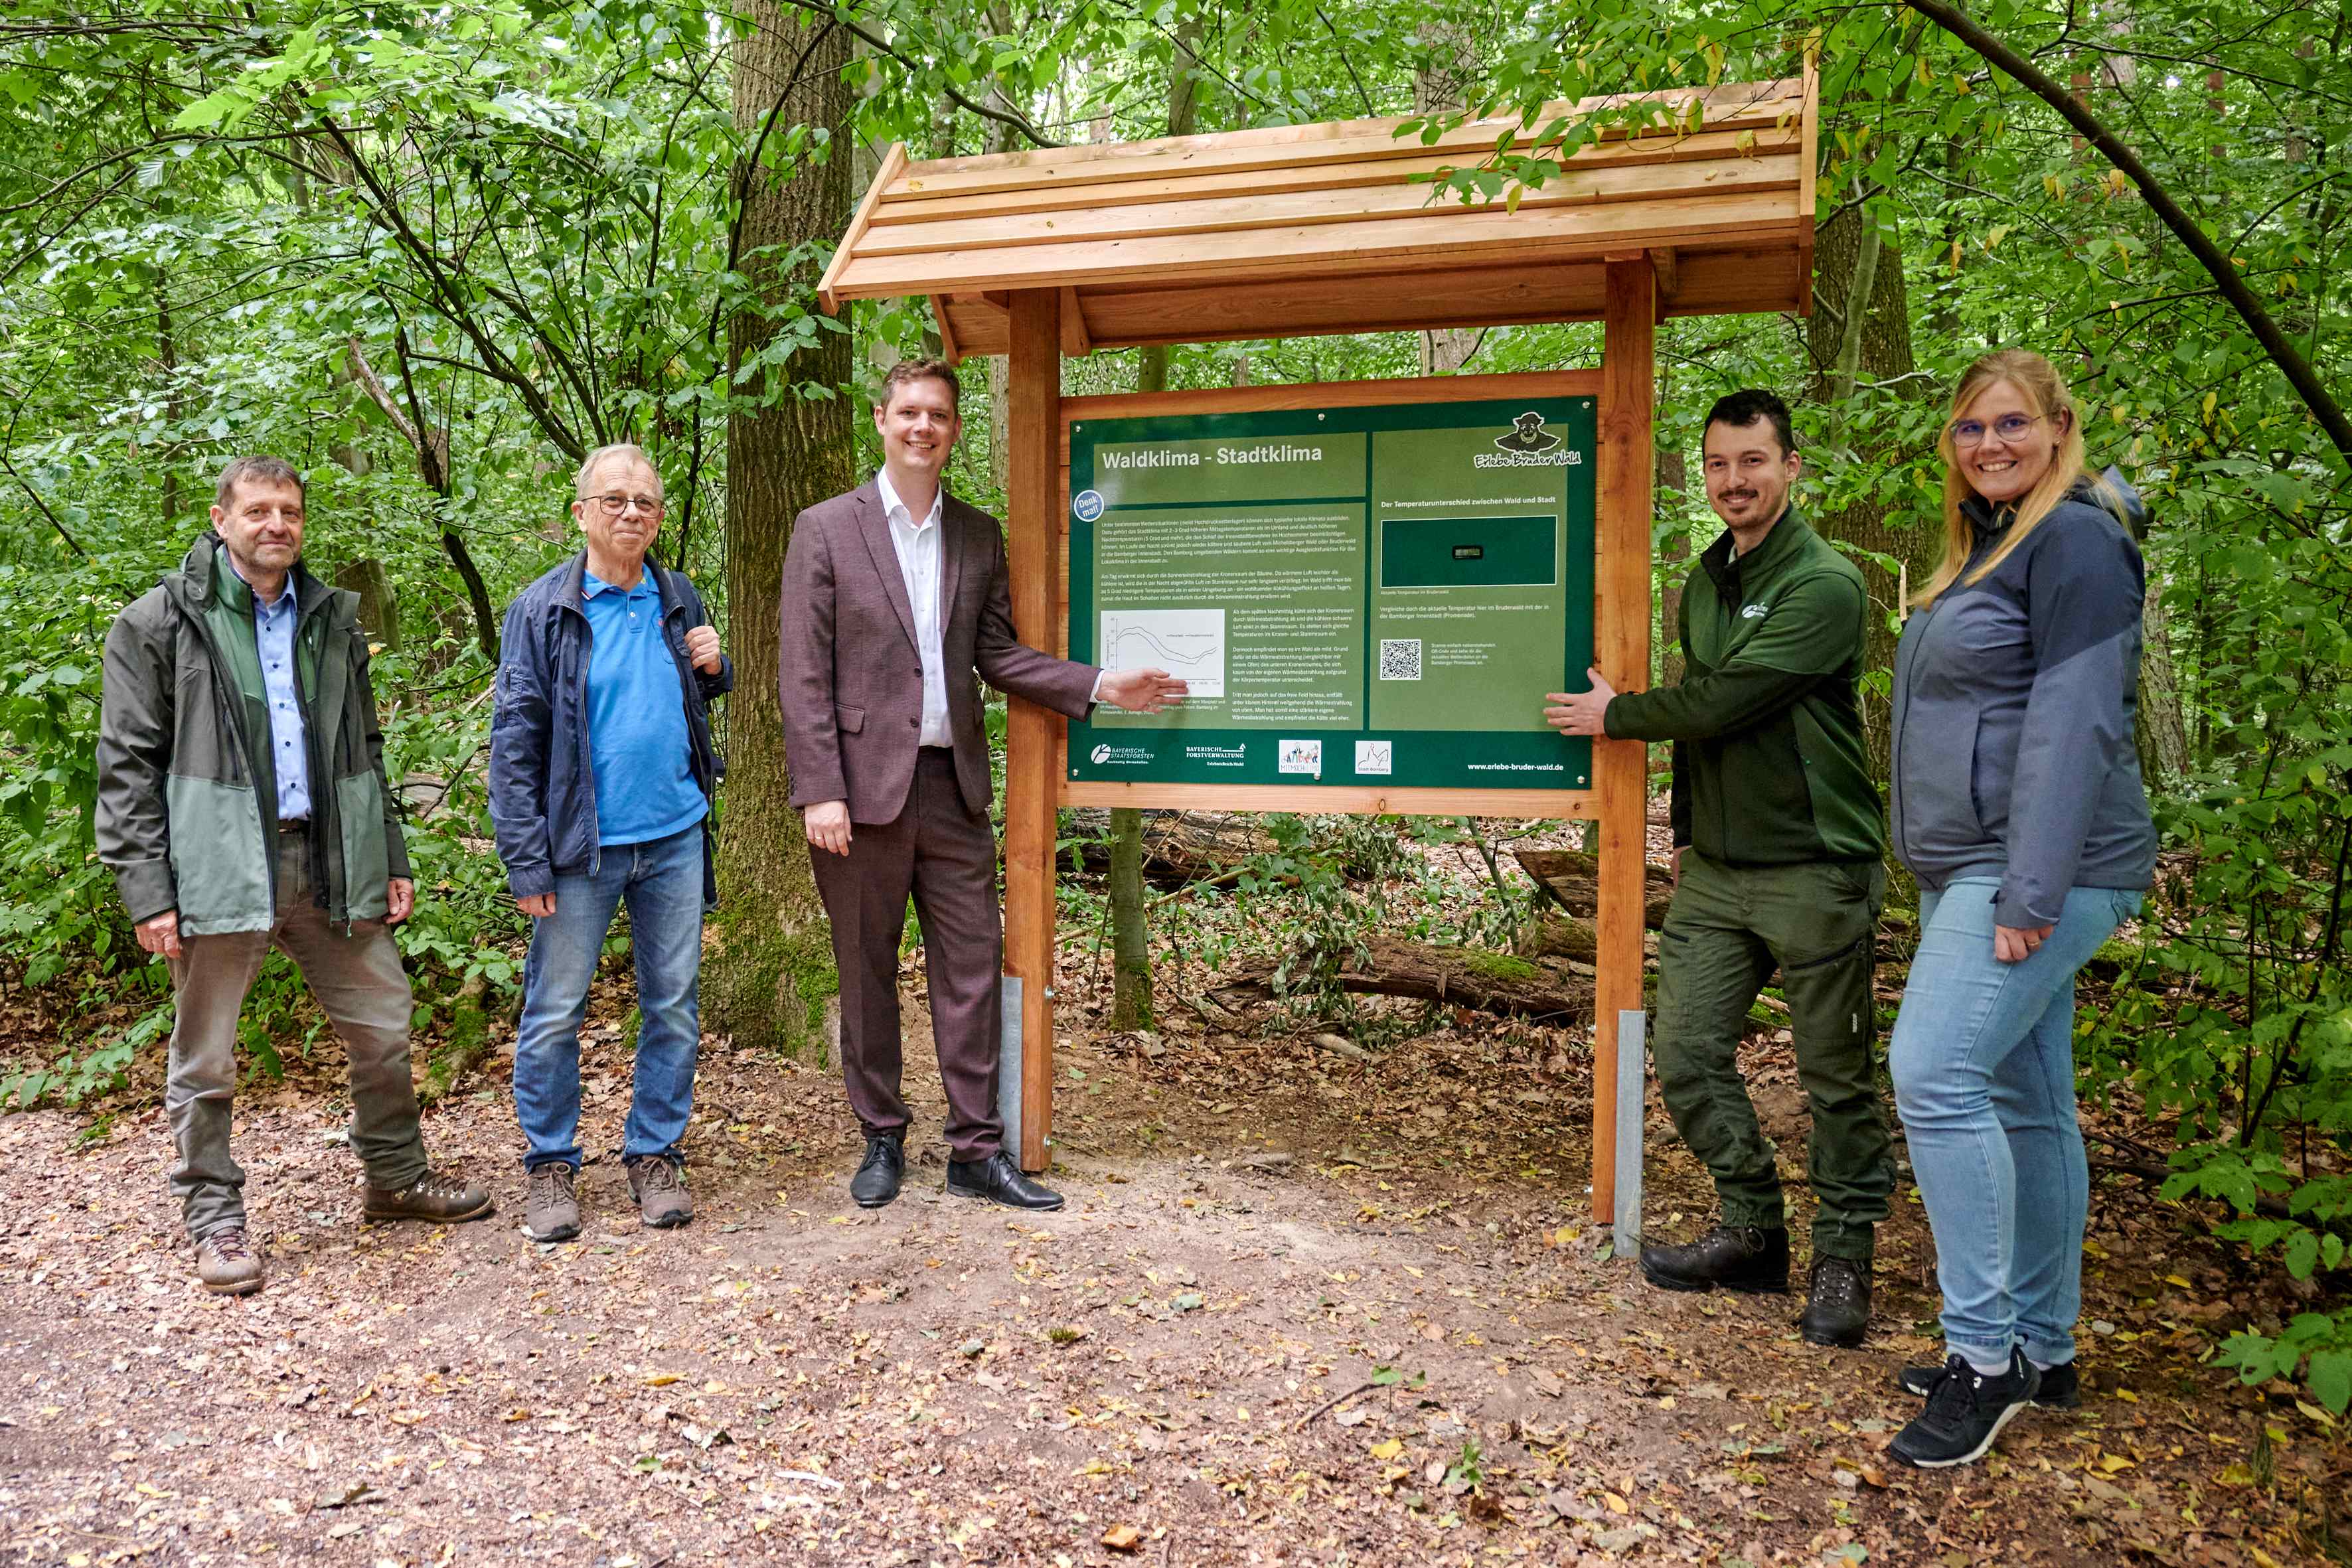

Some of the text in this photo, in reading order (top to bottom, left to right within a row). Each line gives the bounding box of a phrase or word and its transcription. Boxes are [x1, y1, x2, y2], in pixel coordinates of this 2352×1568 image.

[1102, 450, 1200, 469] Waldklima
[1216, 445, 1322, 464] Stadtklima
[1475, 449, 1582, 467] Erlebe Bruder Wald
[1078, 496, 1097, 508] Denk
[1394, 499, 1470, 508] Temperaturunterschied
[1083, 505, 1099, 517] mal!
